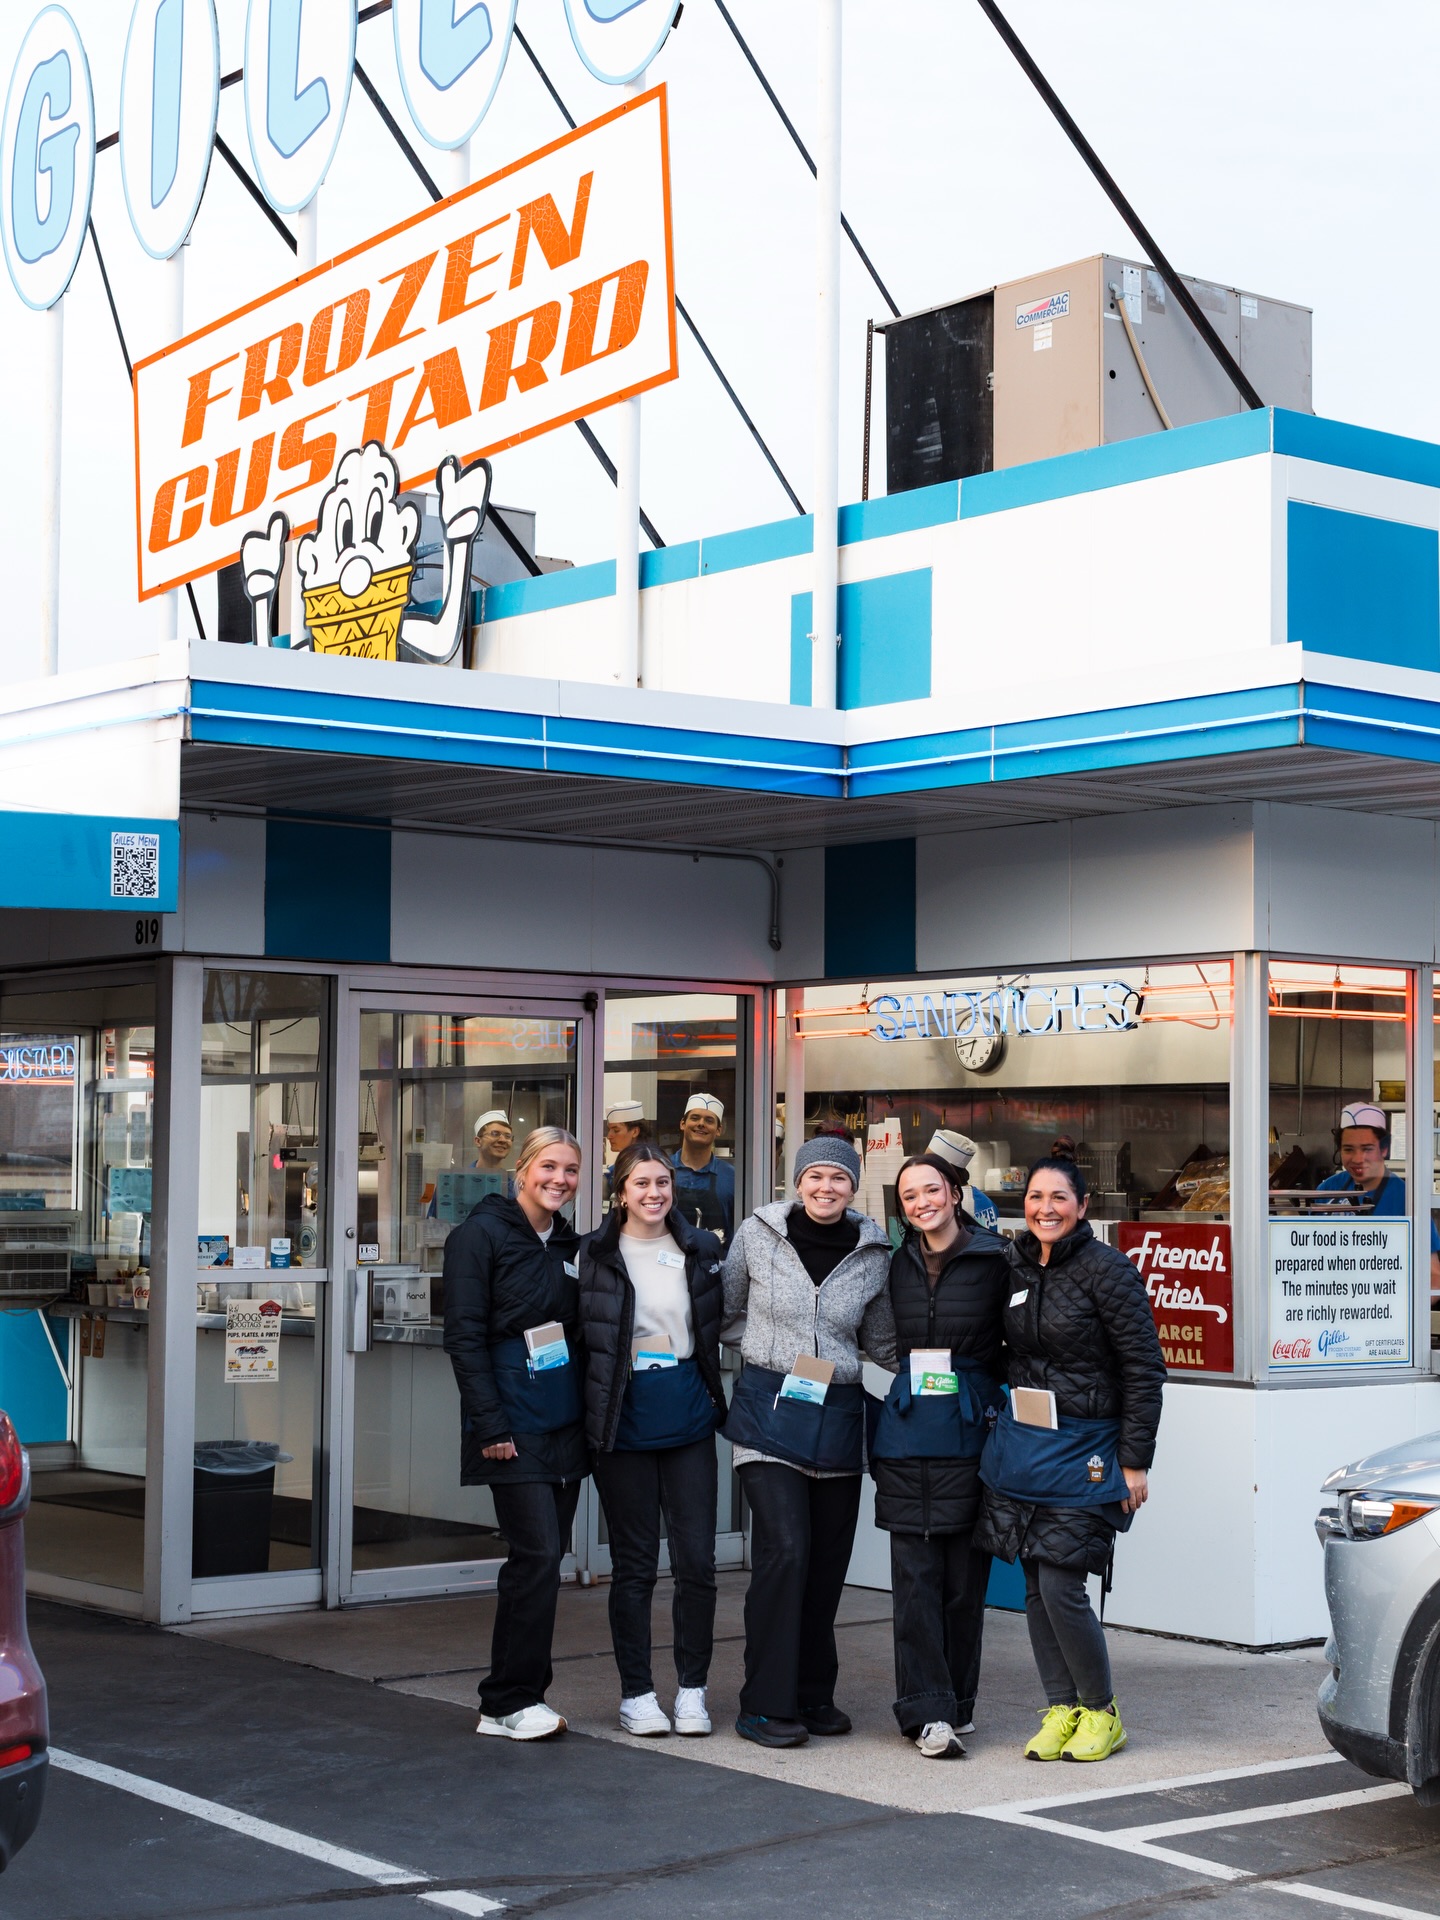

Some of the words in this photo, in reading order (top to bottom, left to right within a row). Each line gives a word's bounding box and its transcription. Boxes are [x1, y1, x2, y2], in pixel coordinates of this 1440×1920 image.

[181, 170, 594, 449] FROZEN
[1049, 293, 1069, 308] AAC
[1016, 304, 1068, 325] COMMERCIAL
[147, 259, 650, 554] CUSTARD
[113, 833, 135, 846] GILLES
[138, 835, 158, 847] MENU
[134, 918, 159, 945] 819
[875, 982, 1131, 1040] SANDWICHES
[1290, 1230, 1310, 1247] Our
[1312, 1230, 1337, 1247] food
[1339, 1230, 1349, 1246] is
[1351, 1230, 1388, 1249] freshly
[1125, 1231, 1227, 1273] French
[1275, 1255, 1324, 1275] prepared
[1327, 1255, 1356, 1271] when
[1359, 1255, 1403, 1271] ordered.
[1144, 1273, 1228, 1324] Fries
[1281, 1280, 1302, 1297] The
[1305, 1280, 1349, 1296] minutes
[1351, 1281, 1370, 1299] you
[1373, 1279, 1396, 1295] wait
[1285, 1308, 1304, 1322] are
[1306, 1305, 1337, 1324] richly
[1339, 1304, 1393, 1320] rewarded.
[1157, 1324, 1203, 1342] ARGE
[1318, 1329, 1350, 1357] Gilles
[1364, 1339, 1375, 1347] GIFT
[1375, 1338, 1405, 1347] CERTIFICATES
[1160, 1346, 1205, 1365] MALL
[1378, 1348, 1401, 1356] AVAILABLE
